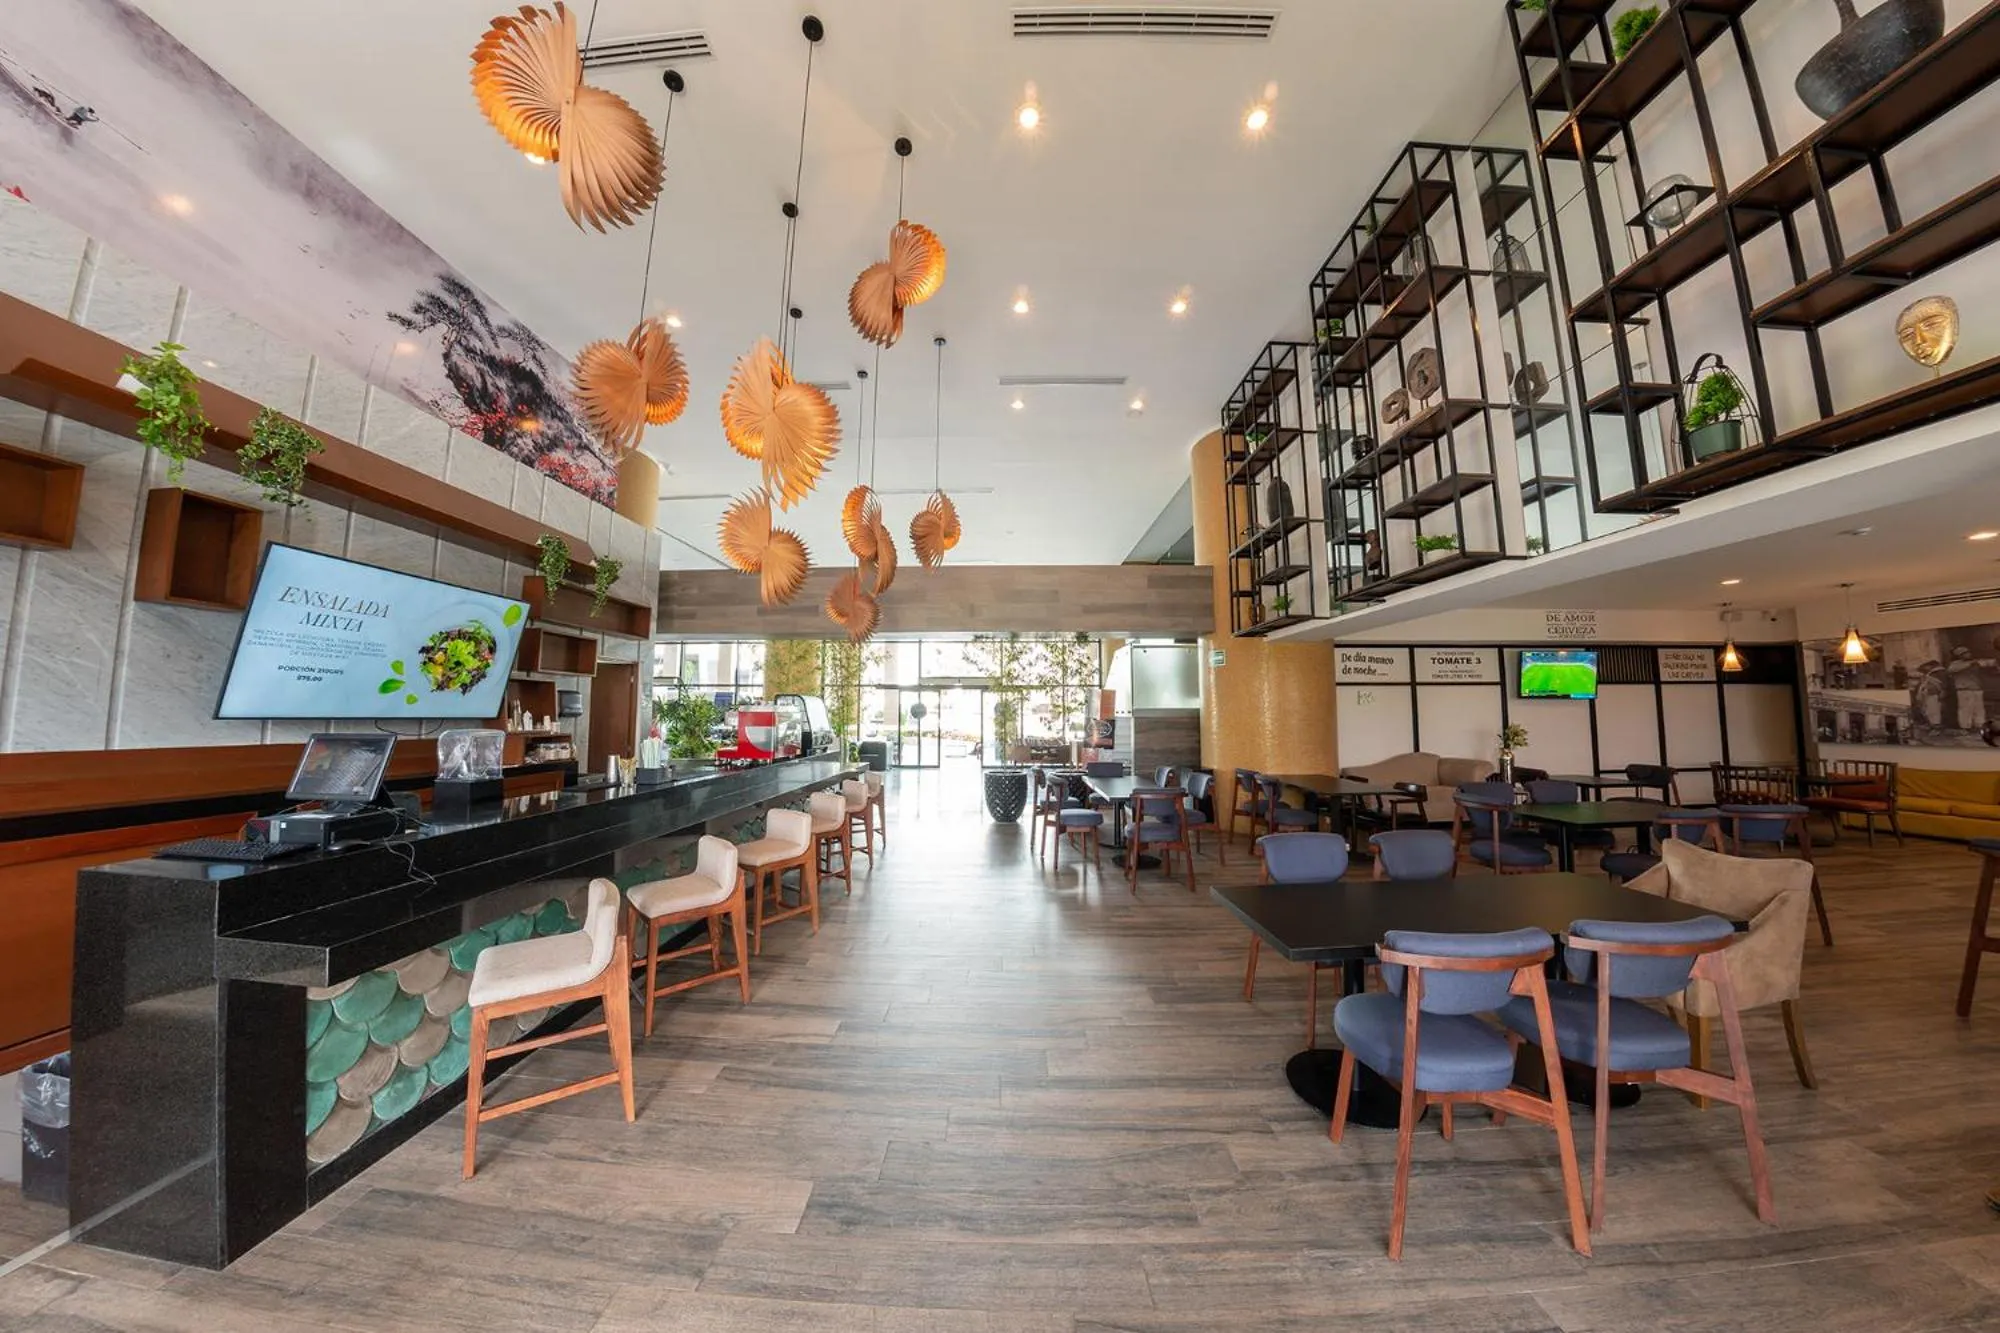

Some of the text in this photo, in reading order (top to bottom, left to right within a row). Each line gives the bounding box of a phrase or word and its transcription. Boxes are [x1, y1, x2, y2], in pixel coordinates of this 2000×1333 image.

[278, 586, 390, 618] ENSALADA
[299, 611, 363, 632] MIXTA
[1546, 614, 1596, 622] DE AMOR
[1341, 653, 1352, 662] De
[1430, 656, 1472, 665] TOMATE
[1342, 664, 1377, 676] de noche
